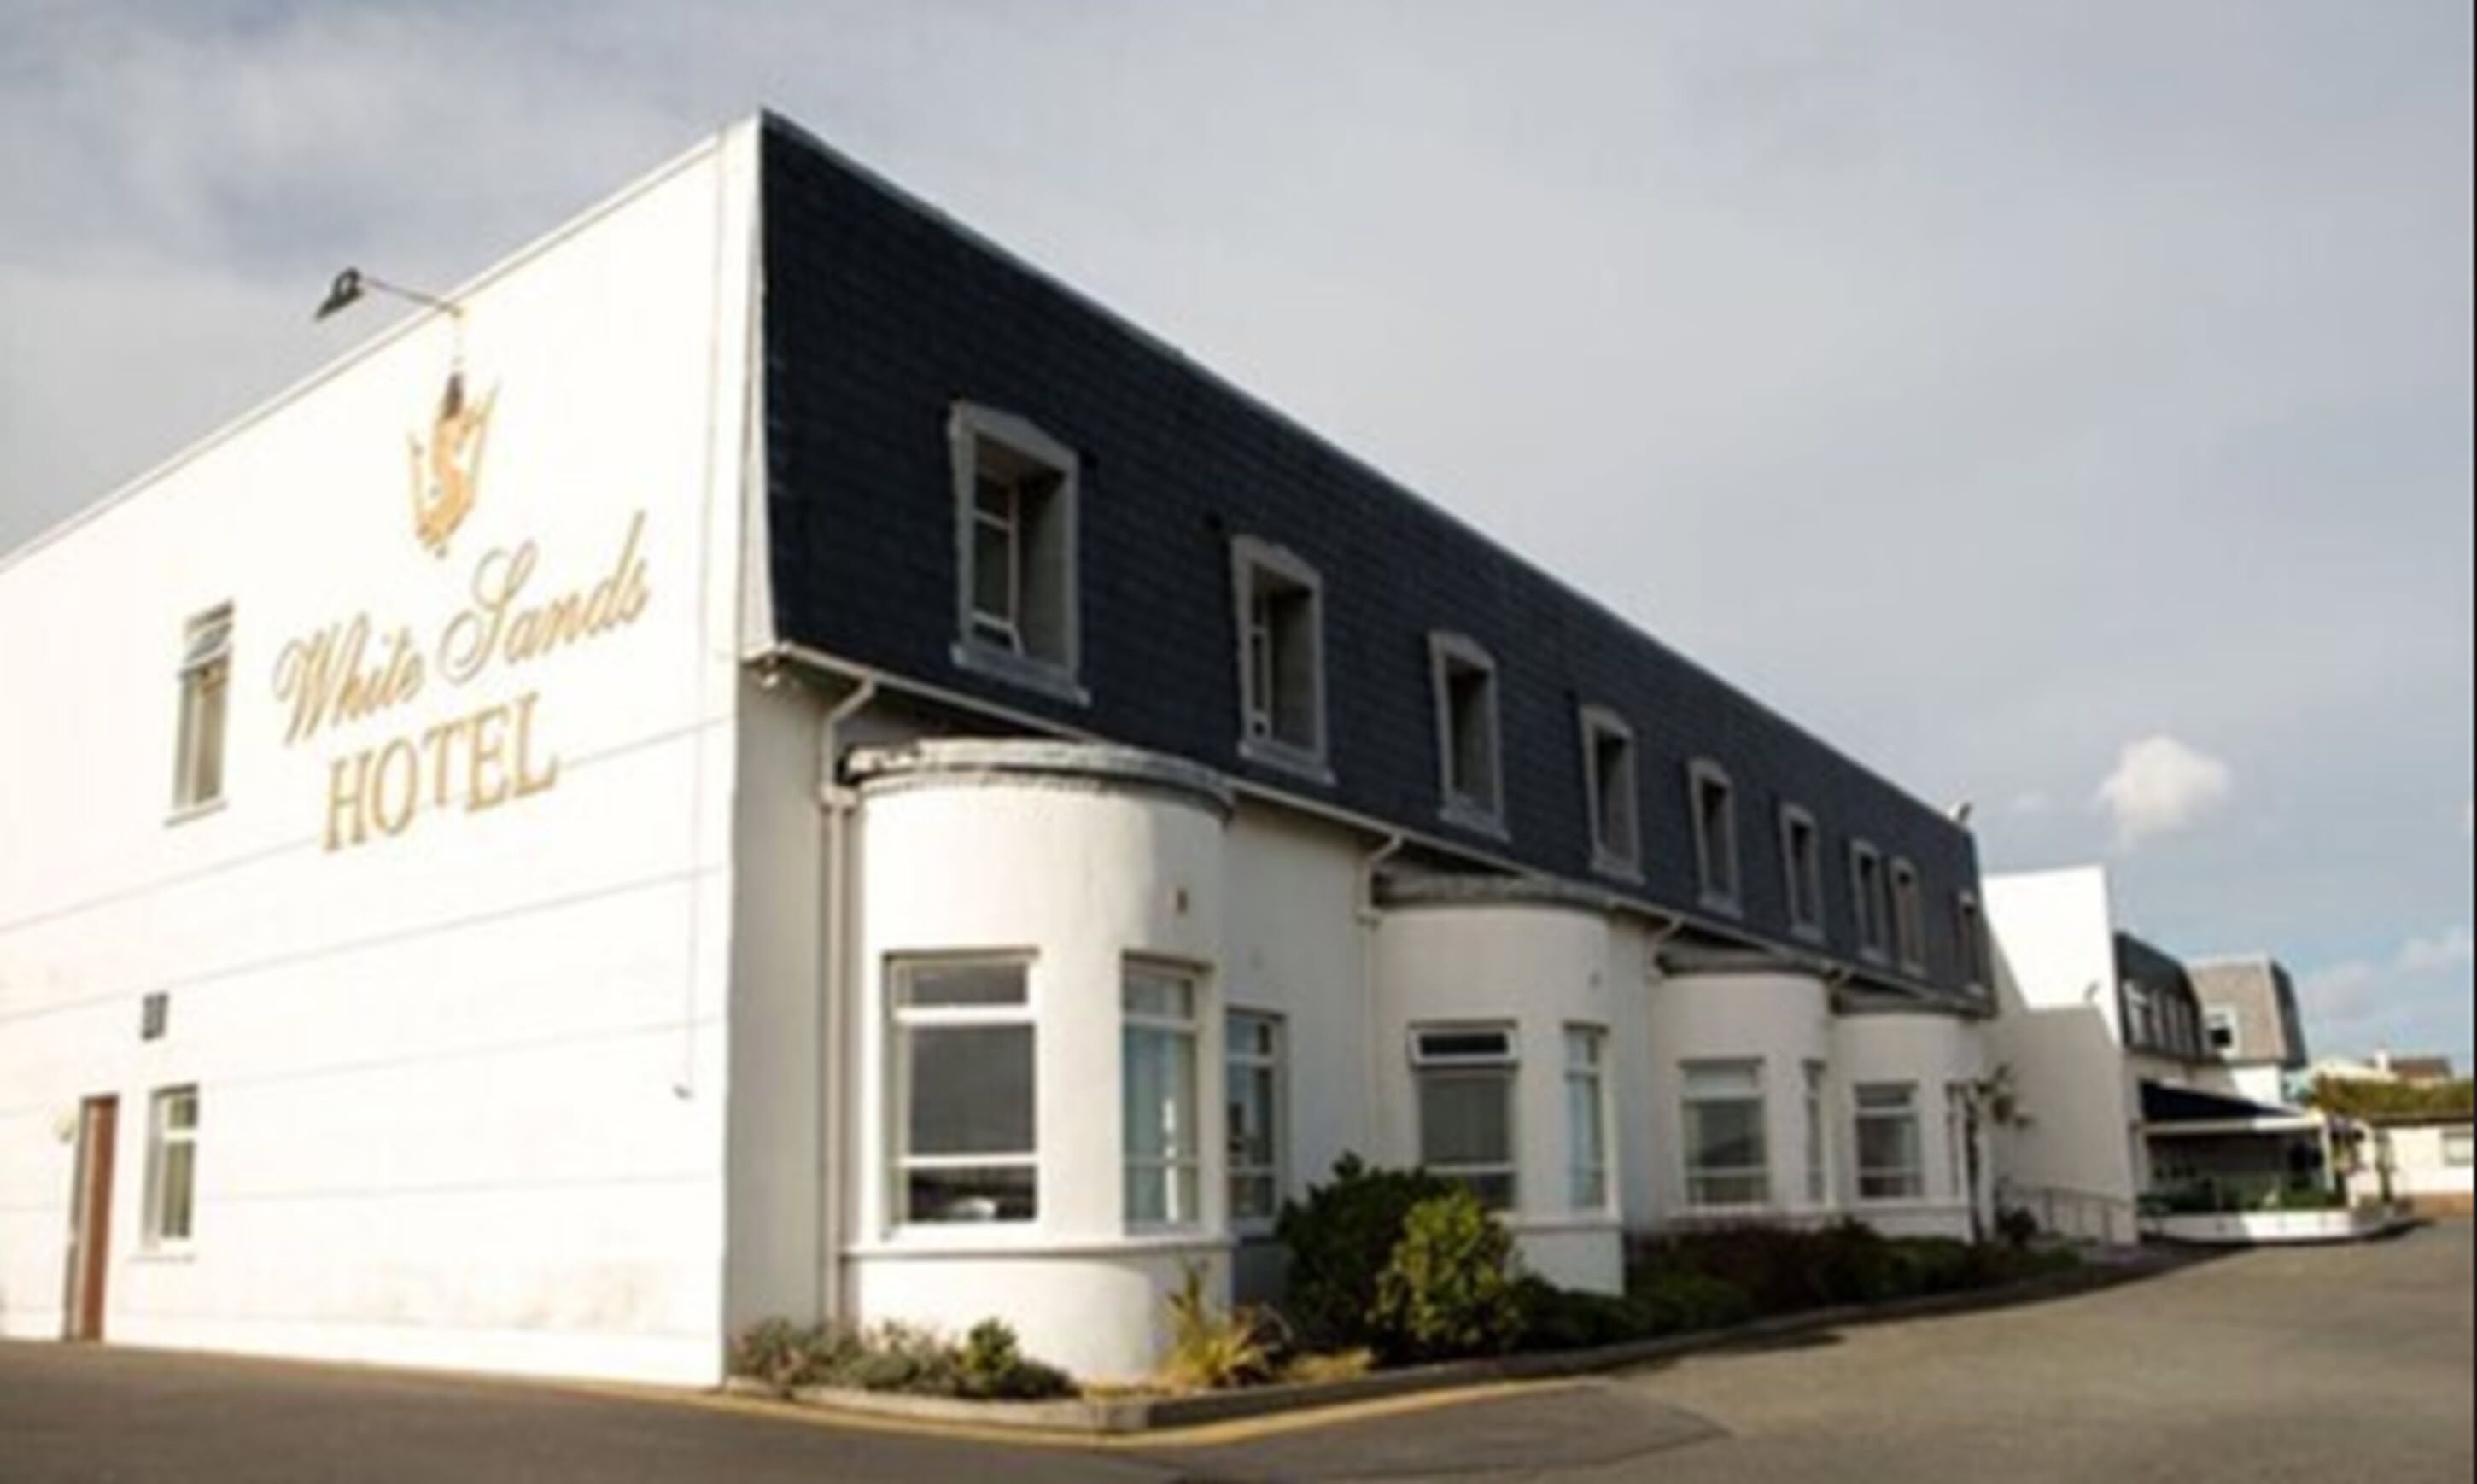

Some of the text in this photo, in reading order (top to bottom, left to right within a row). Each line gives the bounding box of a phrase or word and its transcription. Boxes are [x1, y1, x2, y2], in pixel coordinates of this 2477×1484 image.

[272, 510, 651, 745] White Sands
[324, 691, 558, 852] HOTEL
